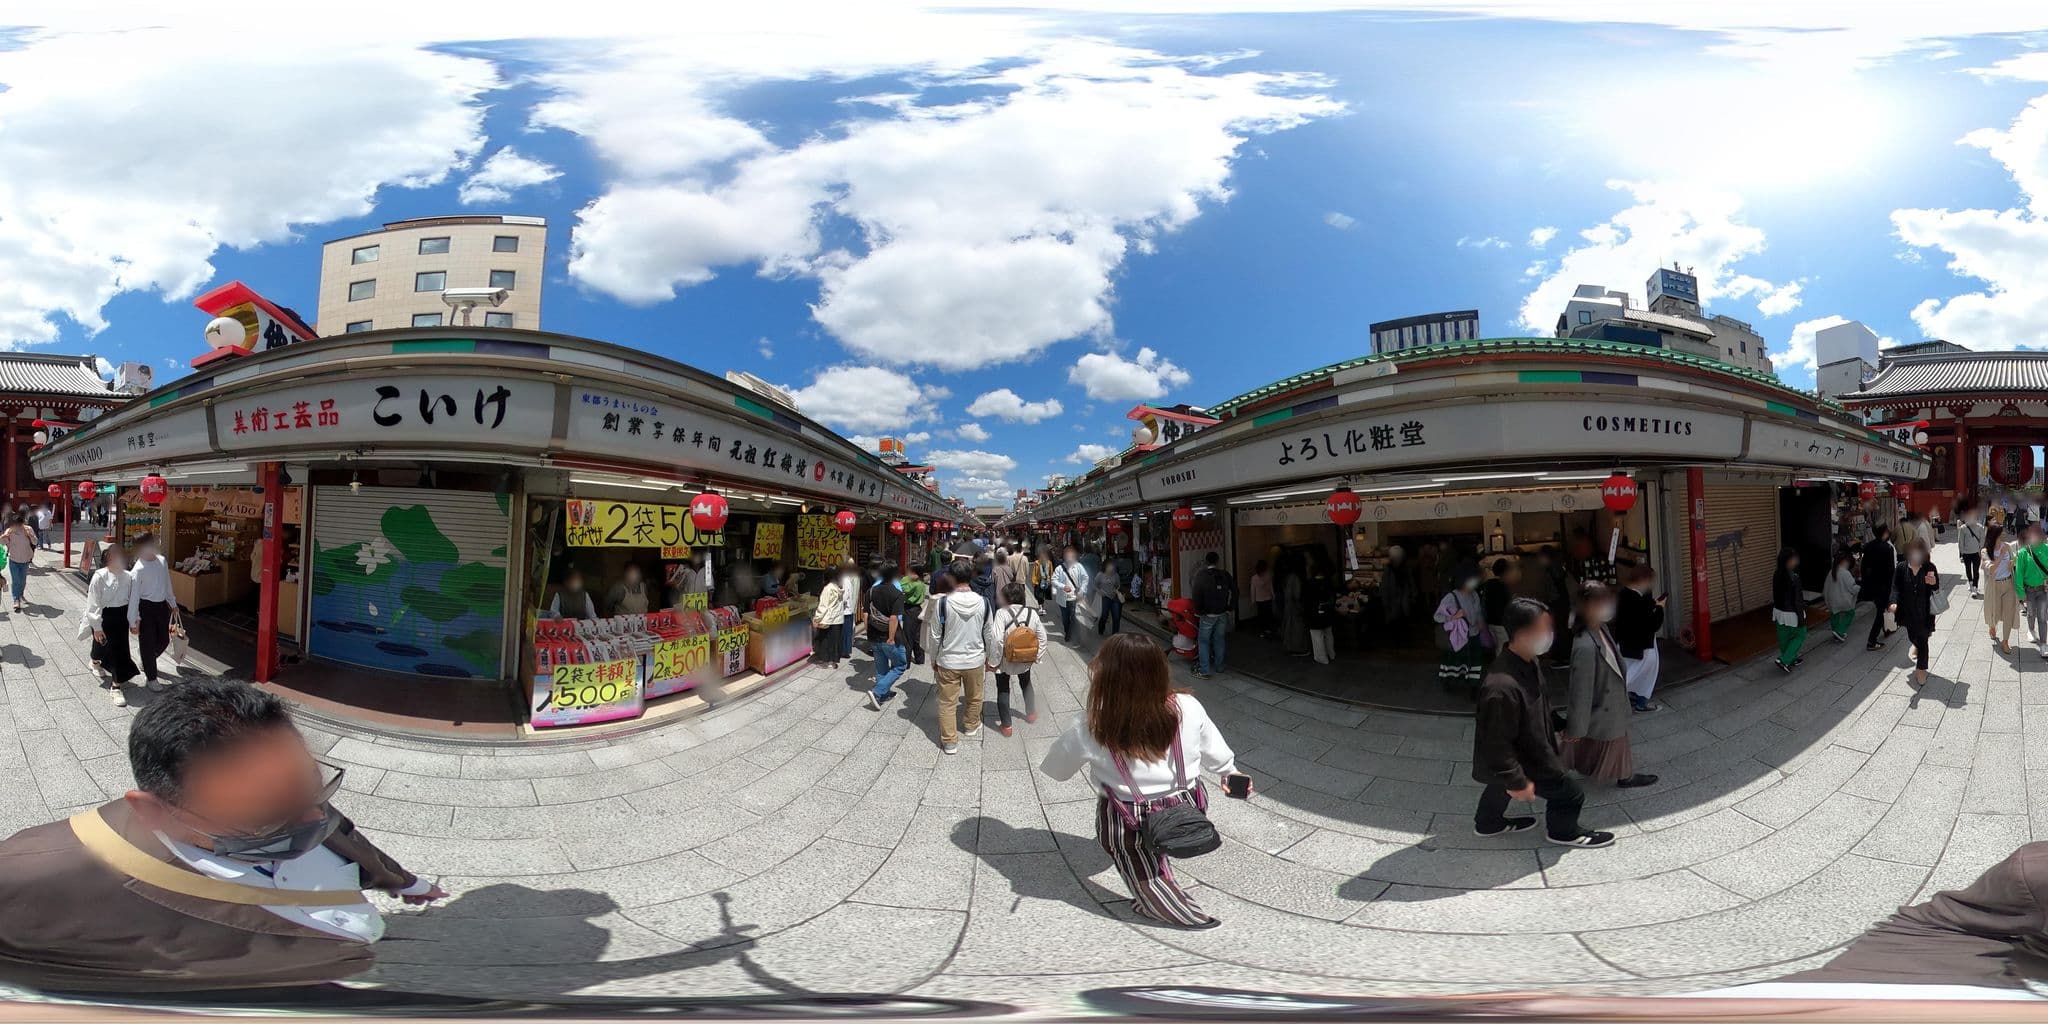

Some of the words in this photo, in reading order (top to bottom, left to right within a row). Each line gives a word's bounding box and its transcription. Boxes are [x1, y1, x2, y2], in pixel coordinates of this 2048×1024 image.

[232, 399, 340, 434] 美術工芸品
[373, 385, 512, 429] こいけ
[1582, 415, 1693, 437] COSMETICS
[1278, 420, 1426, 466] よろし化粧堂
[67, 446, 104, 466] MONKADO
[1161, 469, 1197, 487] YOROSHI
[567, 525, 604, 546] おみやげ
[557, 682, 631, 707] 500円
